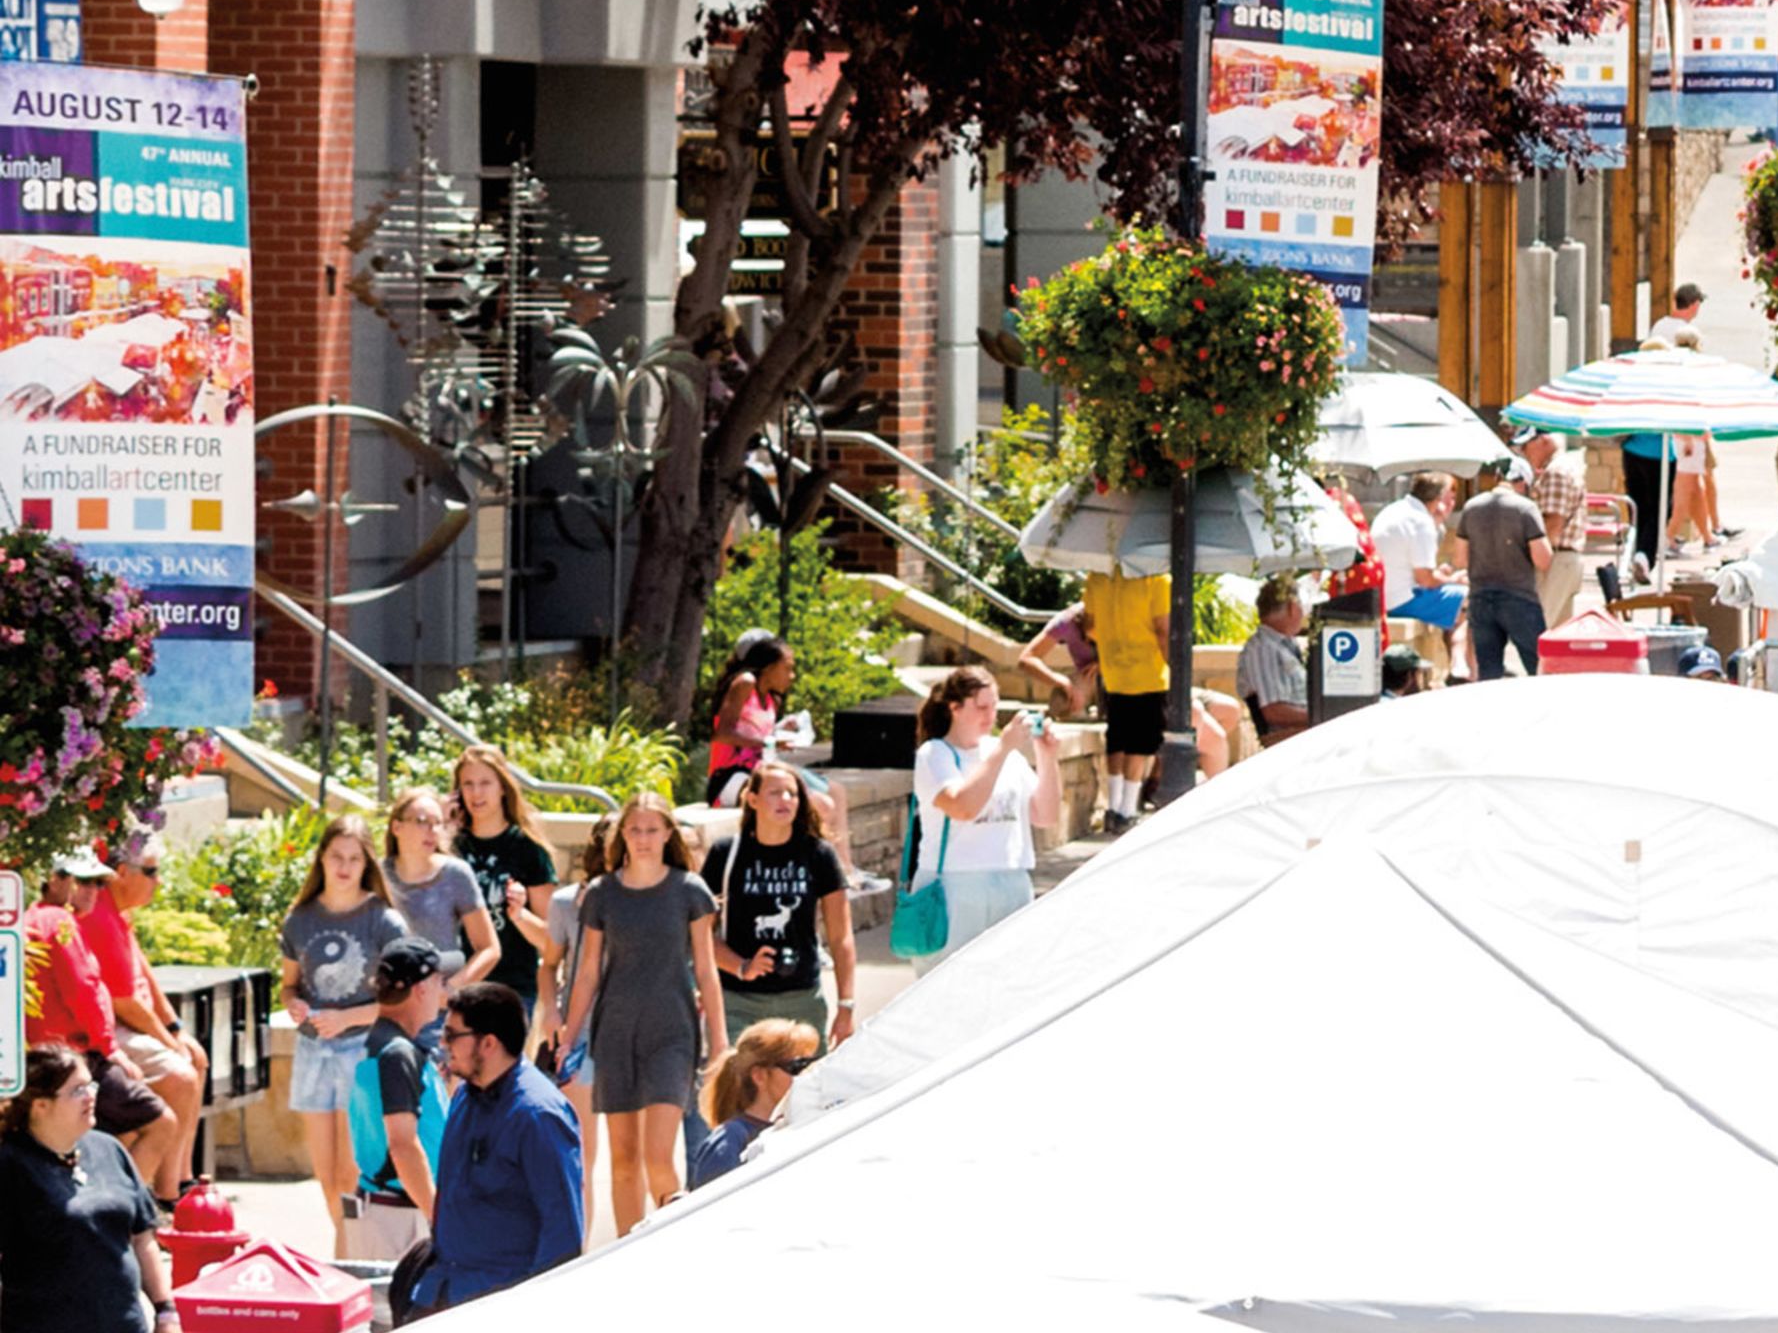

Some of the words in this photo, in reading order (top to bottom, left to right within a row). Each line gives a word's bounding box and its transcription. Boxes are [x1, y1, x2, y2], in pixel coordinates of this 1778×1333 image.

[1234, 4, 1374, 40] artsfestival
[13, 90, 142, 123] AUGUST
[151, 102, 229, 131] 12-14
[0, 154, 61, 179] kimball
[169, 147, 232, 168] ANNUAL
[1227, 169, 1237, 181] A
[1240, 170, 1326, 187] FUNDRAISER
[1330, 175, 1356, 188] FOR
[22, 175, 235, 222] artsfestival
[22, 435, 38, 454] A
[43, 435, 177, 455] FUNDRAISER
[183, 436, 221, 457] FOR
[22, 464, 223, 492] kimballartcenter
[161, 556, 229, 577] BANK
[196, 1306, 230, 1316] bottles
[233, 1307, 251, 1317] and
[254, 1309, 278, 1318] cans
[279, 1309, 299, 1321] only
